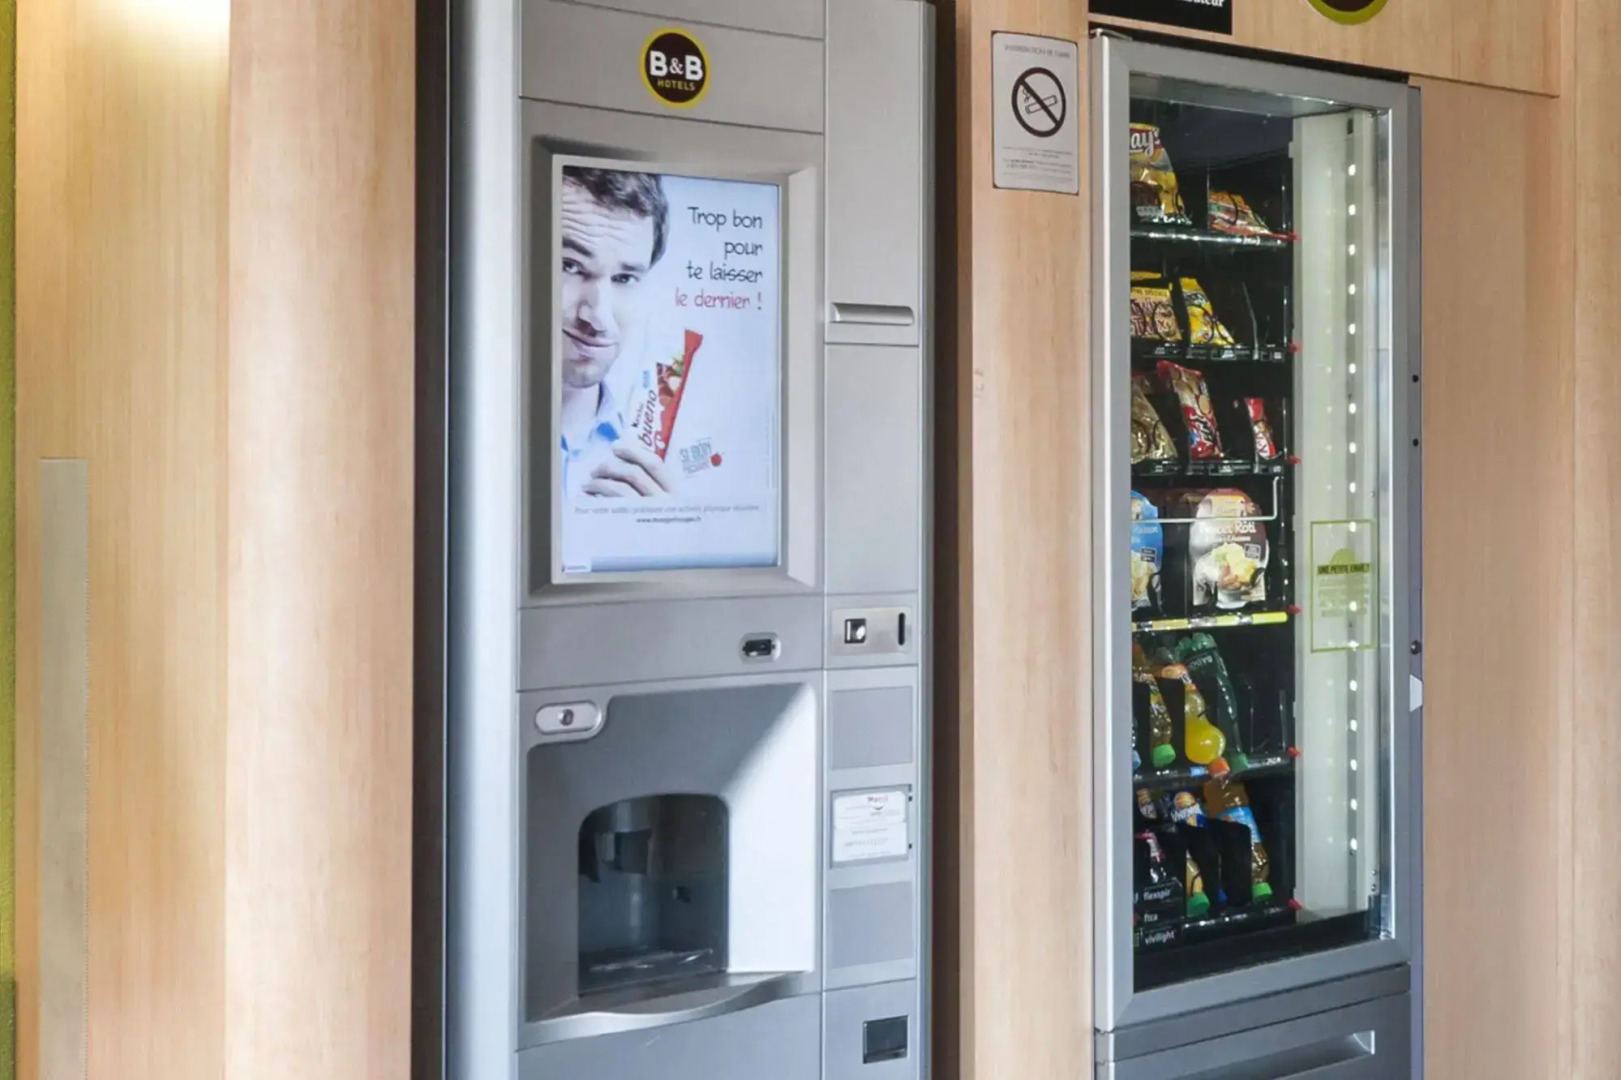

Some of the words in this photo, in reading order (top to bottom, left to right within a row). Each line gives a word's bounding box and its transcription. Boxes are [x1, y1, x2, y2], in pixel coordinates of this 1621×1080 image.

[649, 50, 704, 81] B&B
[657, 79, 696, 91] HOTELS
[1130, 127, 1161, 157] ay's
[686, 206, 727, 232] Trop
[732, 208, 763, 229] bon
[724, 241, 763, 260] pour
[686, 260, 703, 279] te
[710, 260, 763, 283] laisser
[675, 287, 688, 306] le
[693, 288, 750, 309] dernier
[637, 389, 657, 447] bueno
